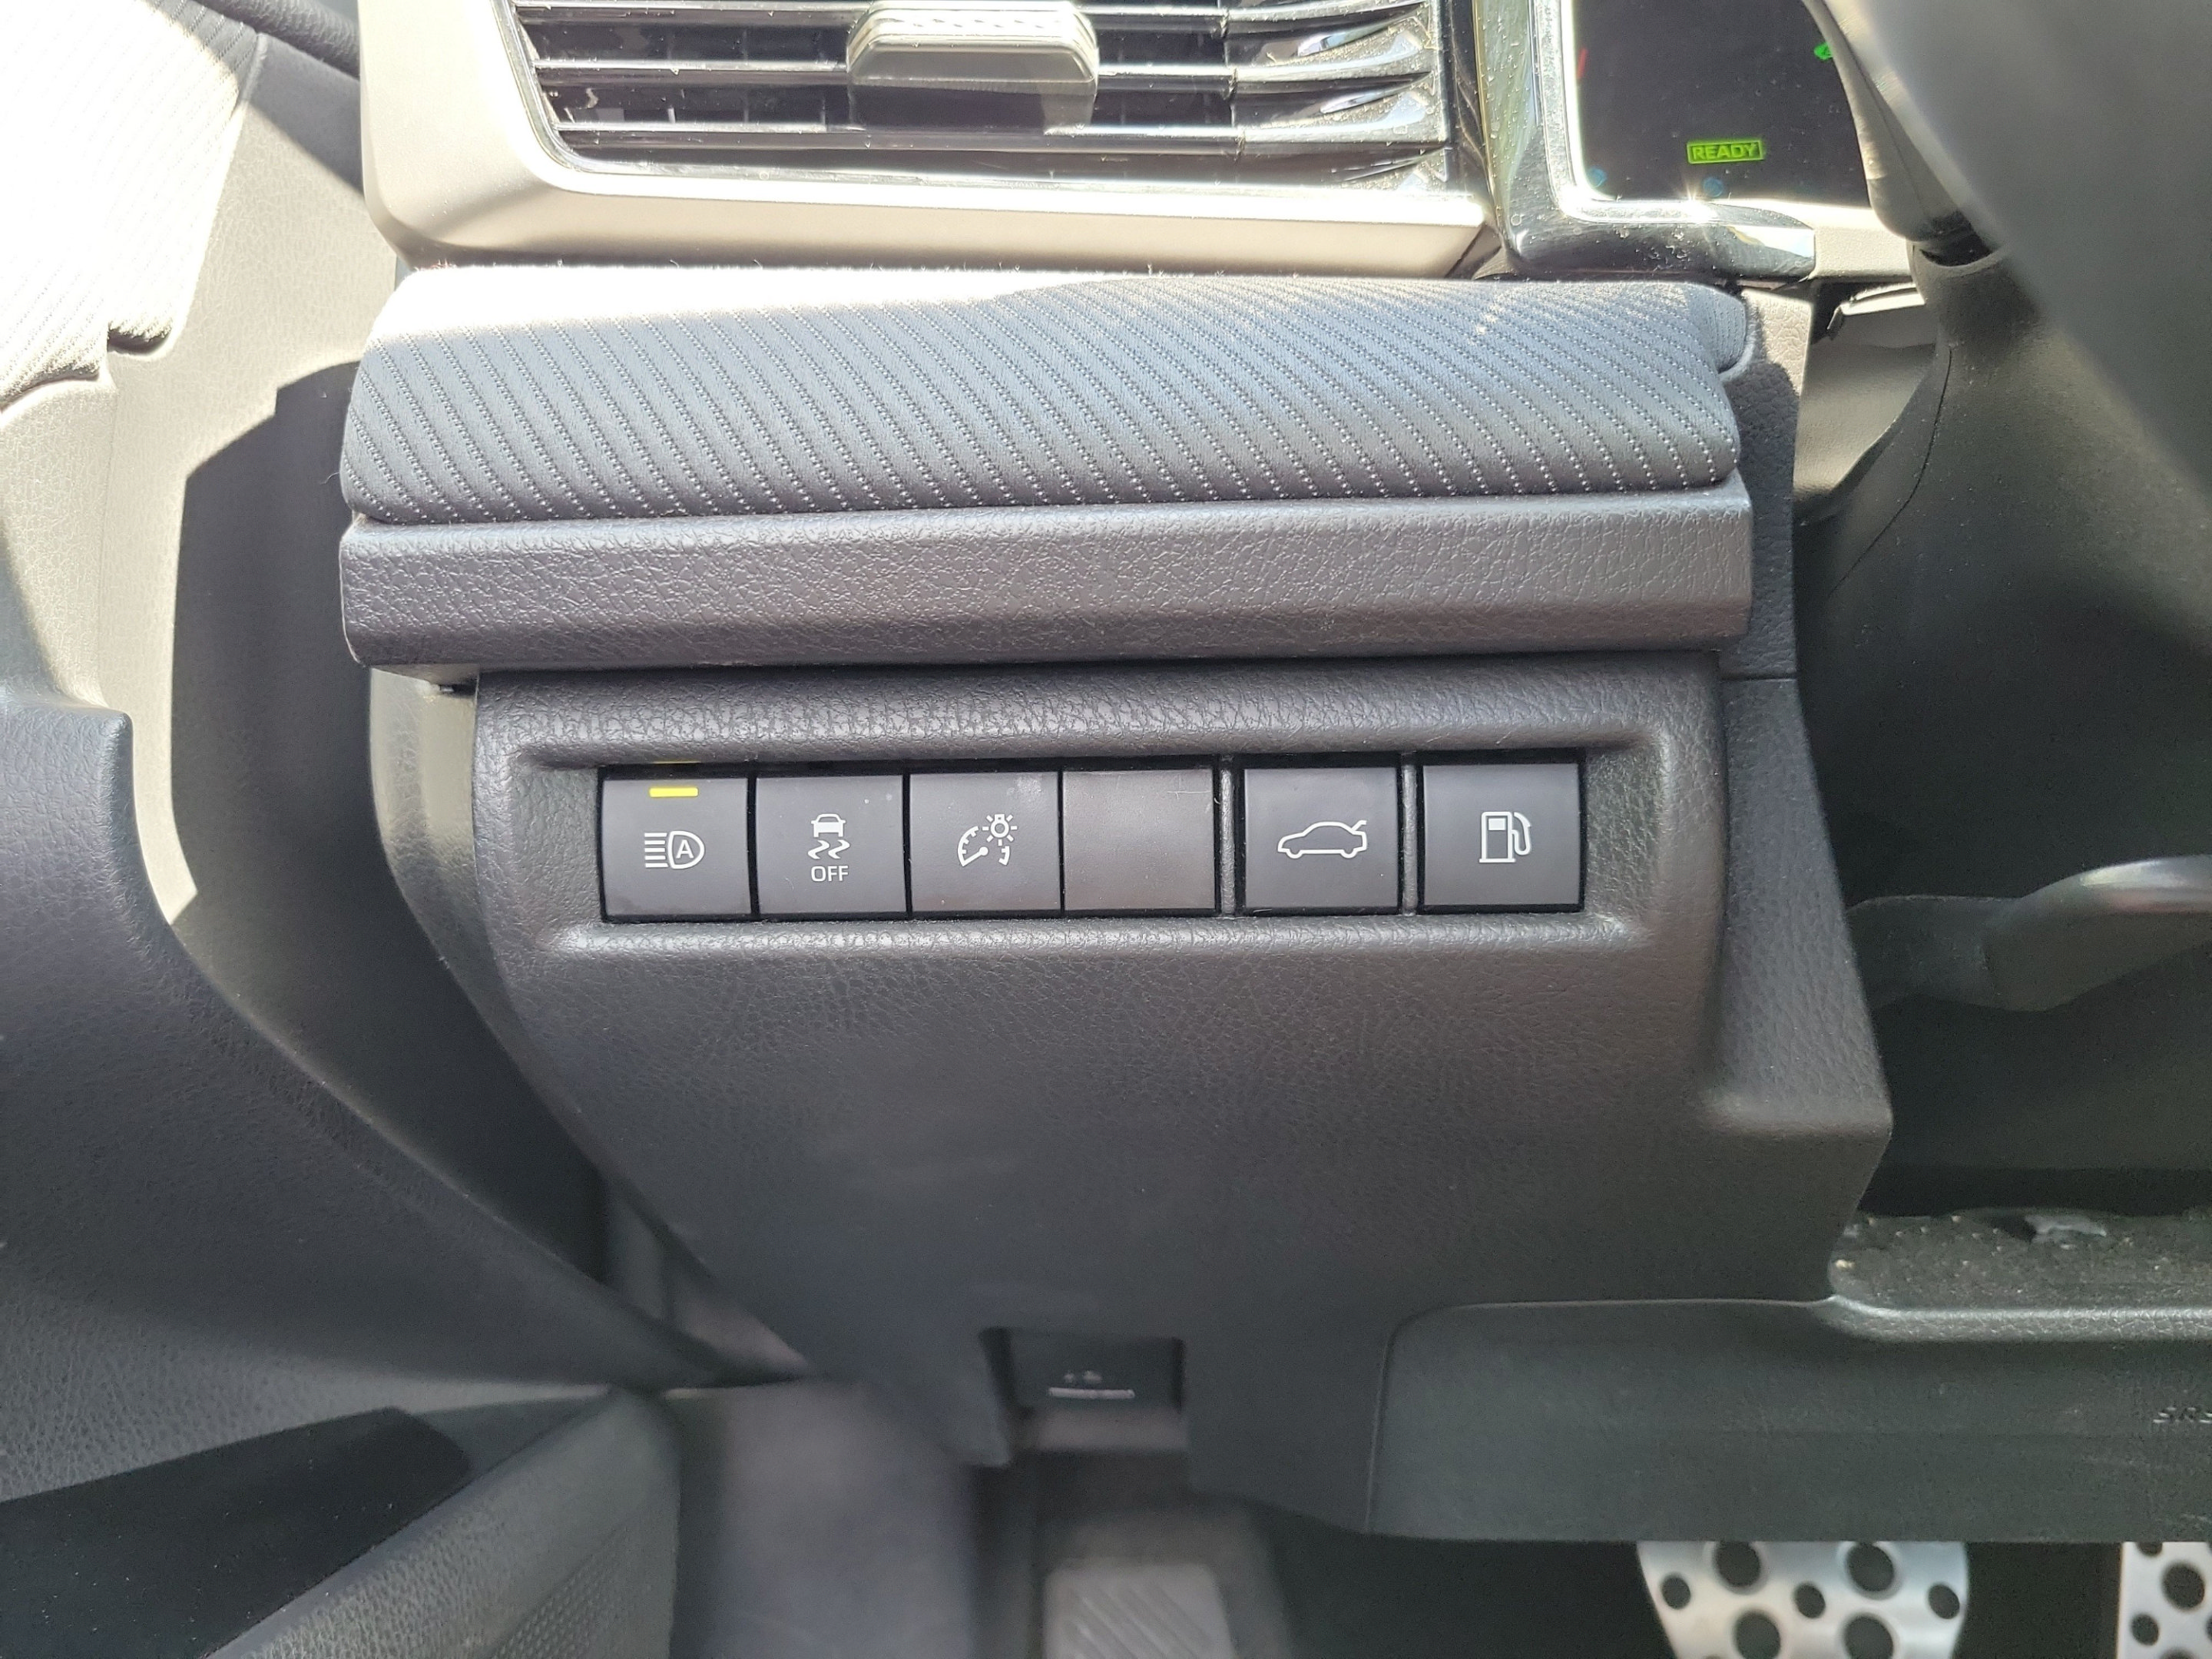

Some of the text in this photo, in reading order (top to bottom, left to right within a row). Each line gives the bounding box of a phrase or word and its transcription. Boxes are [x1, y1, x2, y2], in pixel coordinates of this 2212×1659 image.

[1692, 144, 1757, 161] READY
[676, 839, 694, 859] A
[811, 865, 849, 882] OFF
